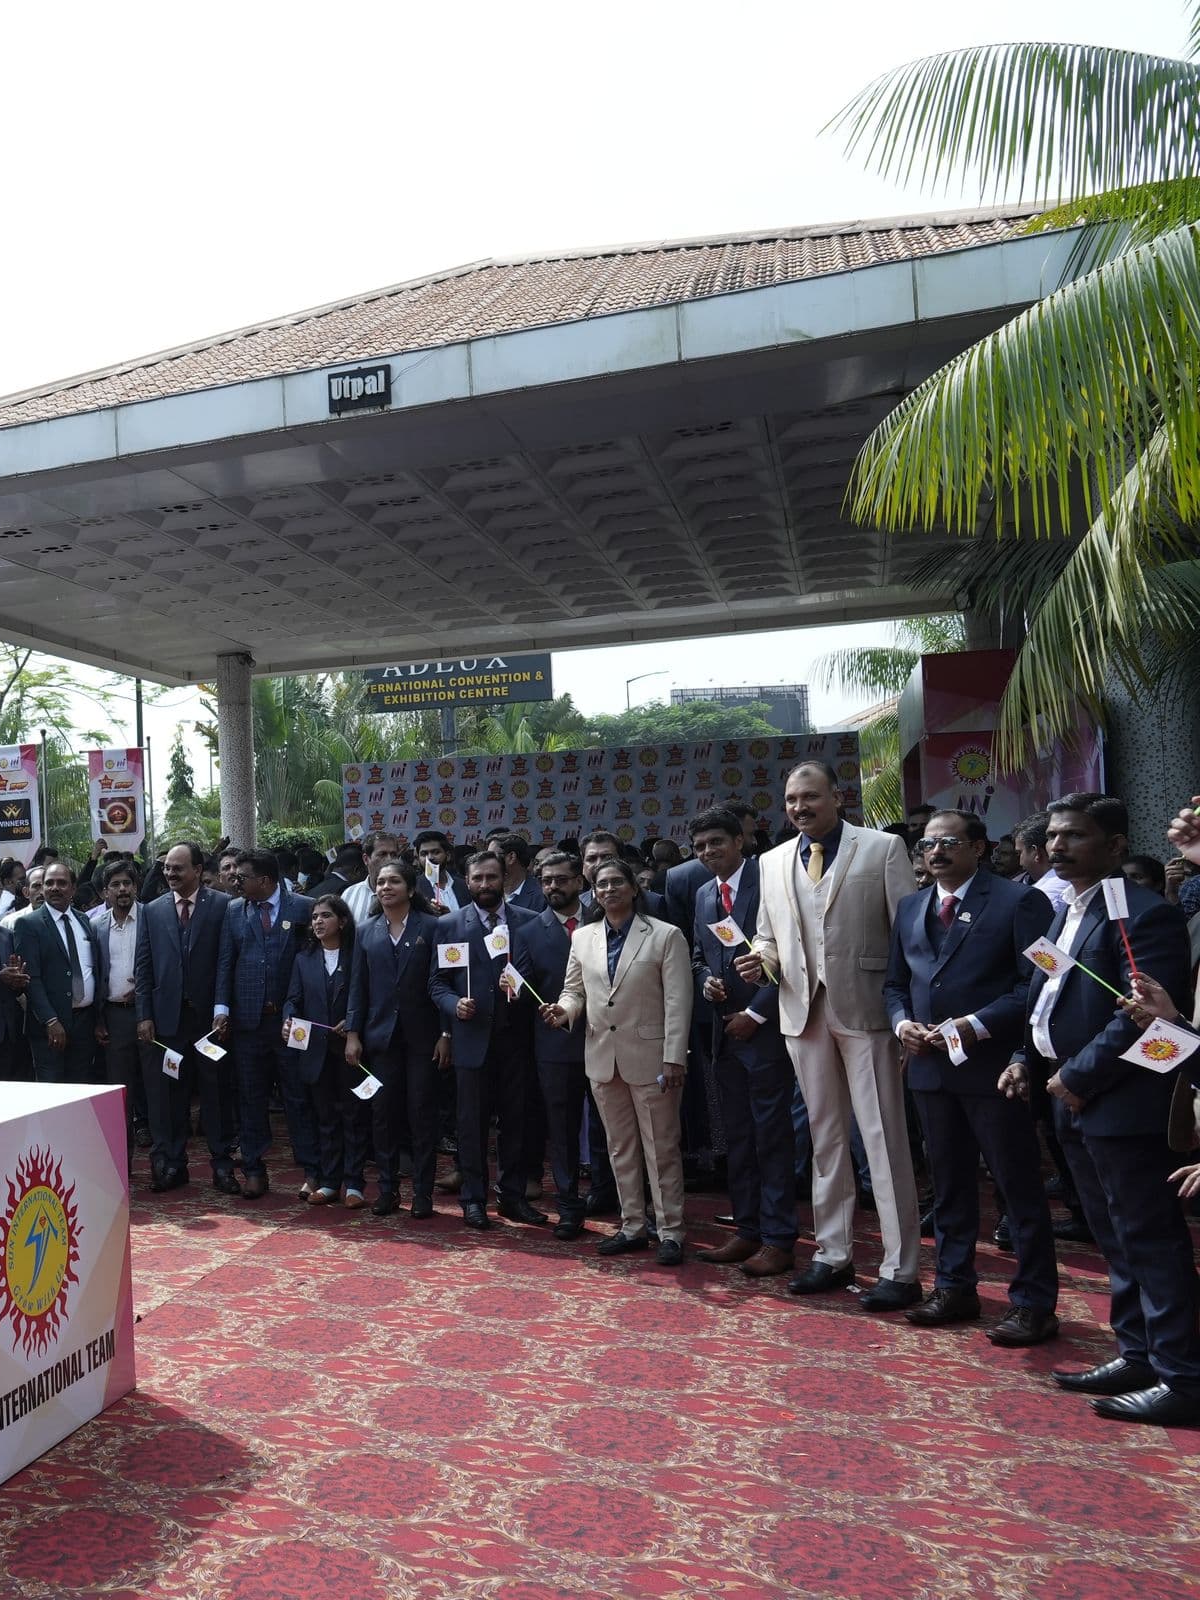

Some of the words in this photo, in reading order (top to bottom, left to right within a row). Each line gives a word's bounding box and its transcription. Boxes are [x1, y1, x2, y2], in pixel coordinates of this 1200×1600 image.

[330, 370, 386, 400] Utpal
[370, 679, 446, 694] ERNATIONAL
[449, 671, 531, 687] CONVENTION
[534, 670, 544, 681] &
[384, 690, 456, 705] EXHIBITION
[459, 686, 509, 699] CENTRE
[12, 1191, 58, 1236] INTERNATIONAL
[58, 1212, 67, 1246] TEAM
[85, 1329, 116, 1373] TEAM
